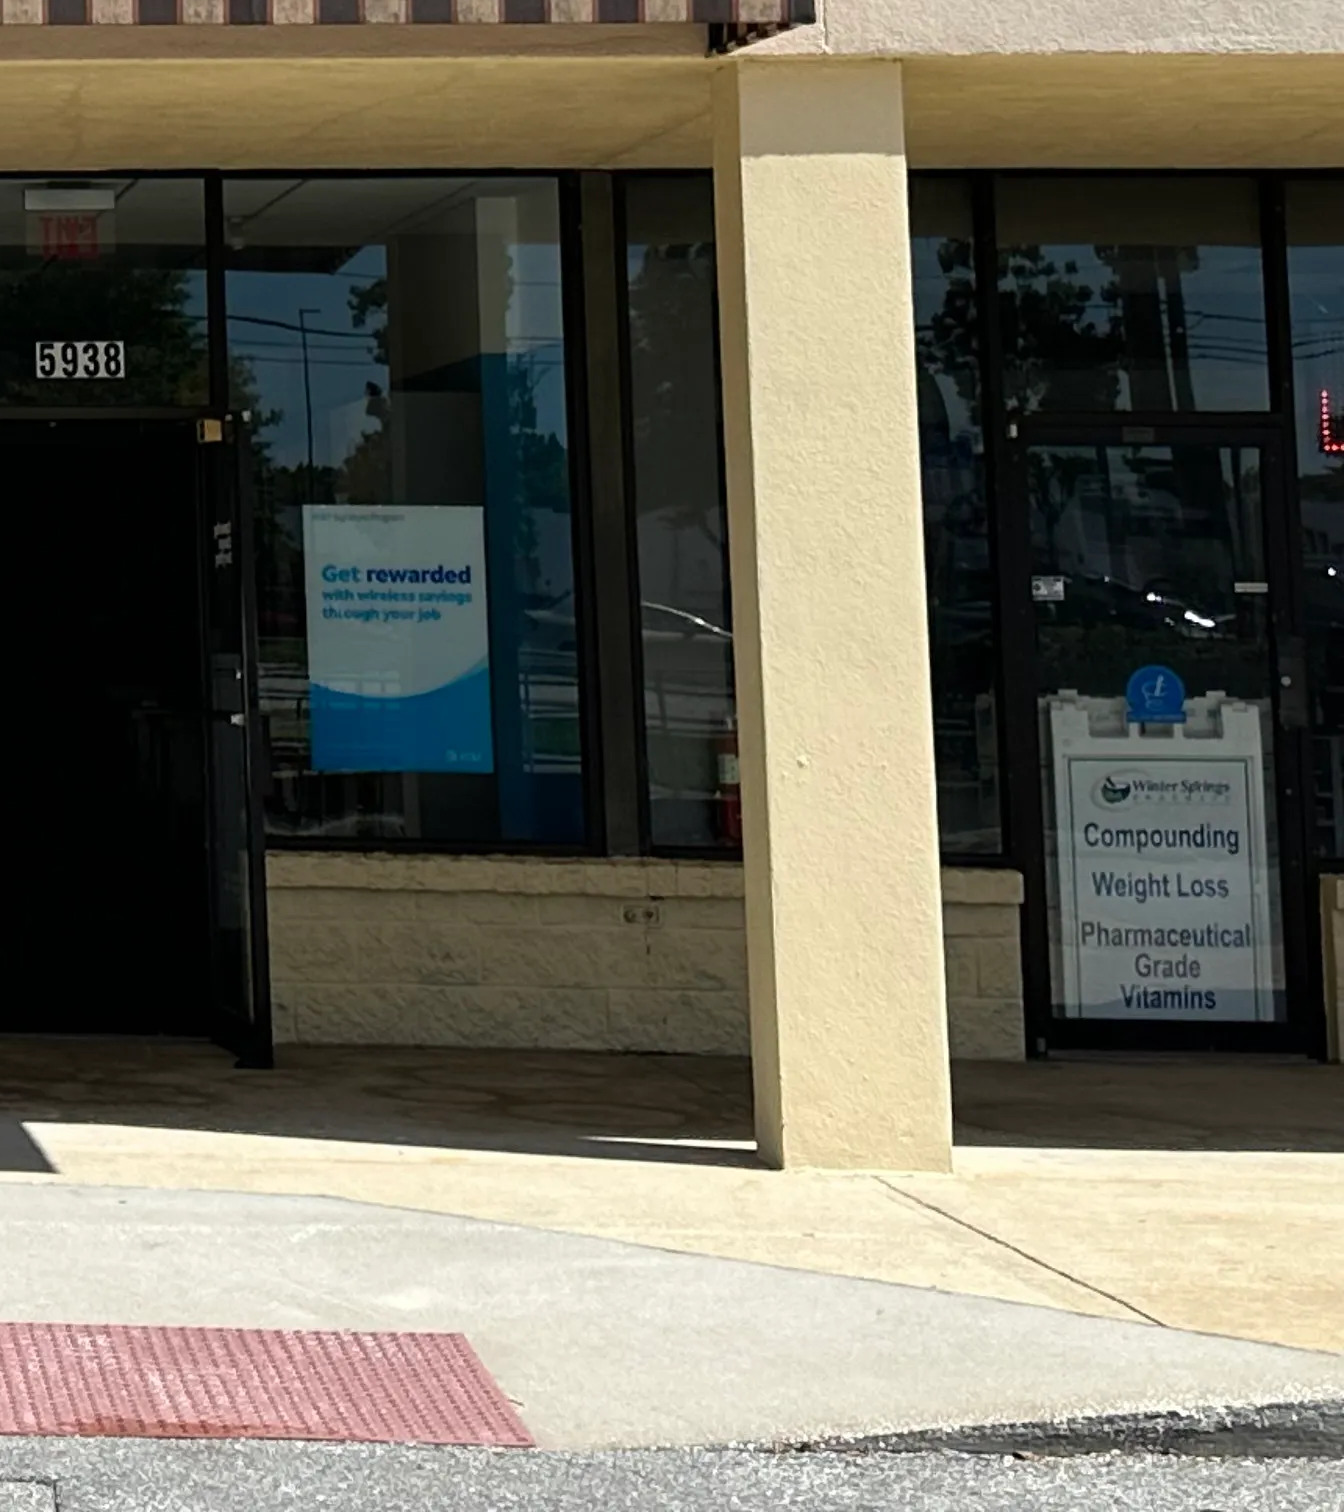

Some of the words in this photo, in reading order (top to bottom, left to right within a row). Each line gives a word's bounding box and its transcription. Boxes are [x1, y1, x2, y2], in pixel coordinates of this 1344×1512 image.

[39, 343, 121, 376] 5938
[321, 564, 361, 583] Get
[366, 565, 472, 584] rewarded
[322, 589, 355, 602] with
[357, 589, 416, 602] wireless
[418, 589, 473, 606] savings
[382, 608, 415, 623] your
[416, 607, 442, 623] job
[1133, 779, 1179, 793] Winter
[1181, 779, 1231, 795] Springs
[1083, 822, 1240, 855] Compounding
[1091, 871, 1171, 904] Weight
[1176, 872, 1230, 899] Loss
[1081, 921, 1252, 948] Pharmaceutical
[1134, 953, 1201, 978] Grade
[1119, 983, 1217, 1010] Vitamins
